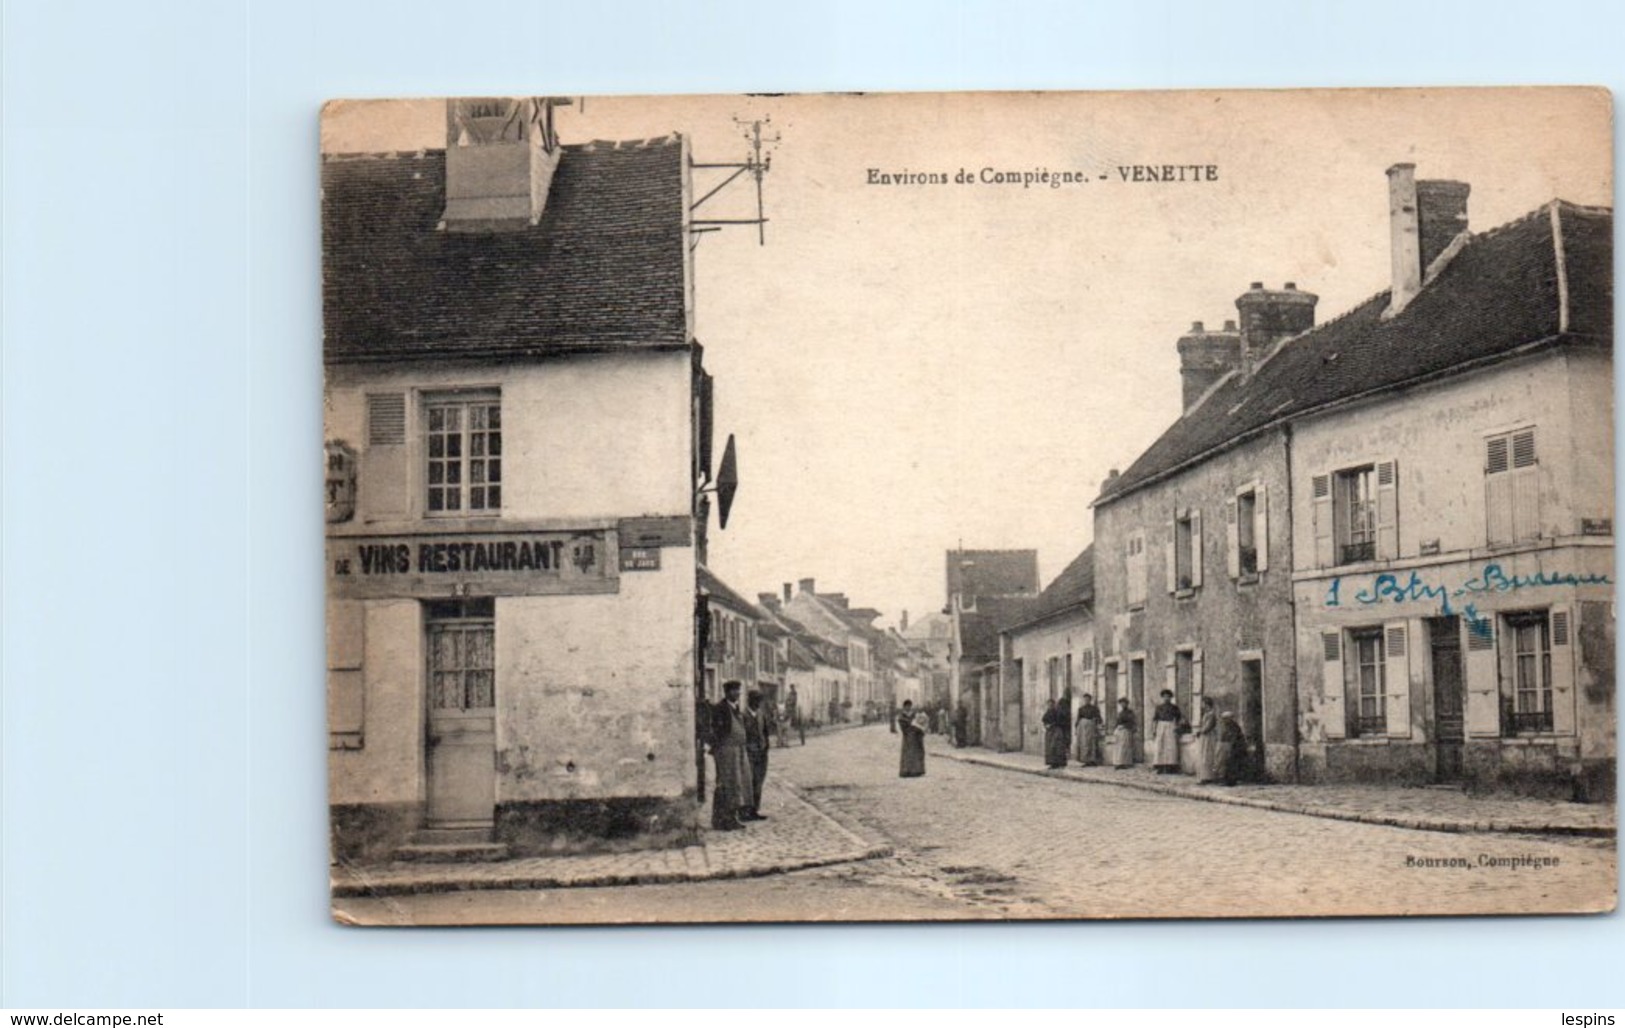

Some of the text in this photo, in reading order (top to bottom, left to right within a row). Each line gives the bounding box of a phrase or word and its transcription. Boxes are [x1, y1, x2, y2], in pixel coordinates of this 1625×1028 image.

[866, 168, 949, 185] Environs
[954, 168, 975, 185] de
[1117, 164, 1220, 182] VENETTE
[358, 543, 410, 574] VINS
[418, 540, 564, 573] RESTAURANT
